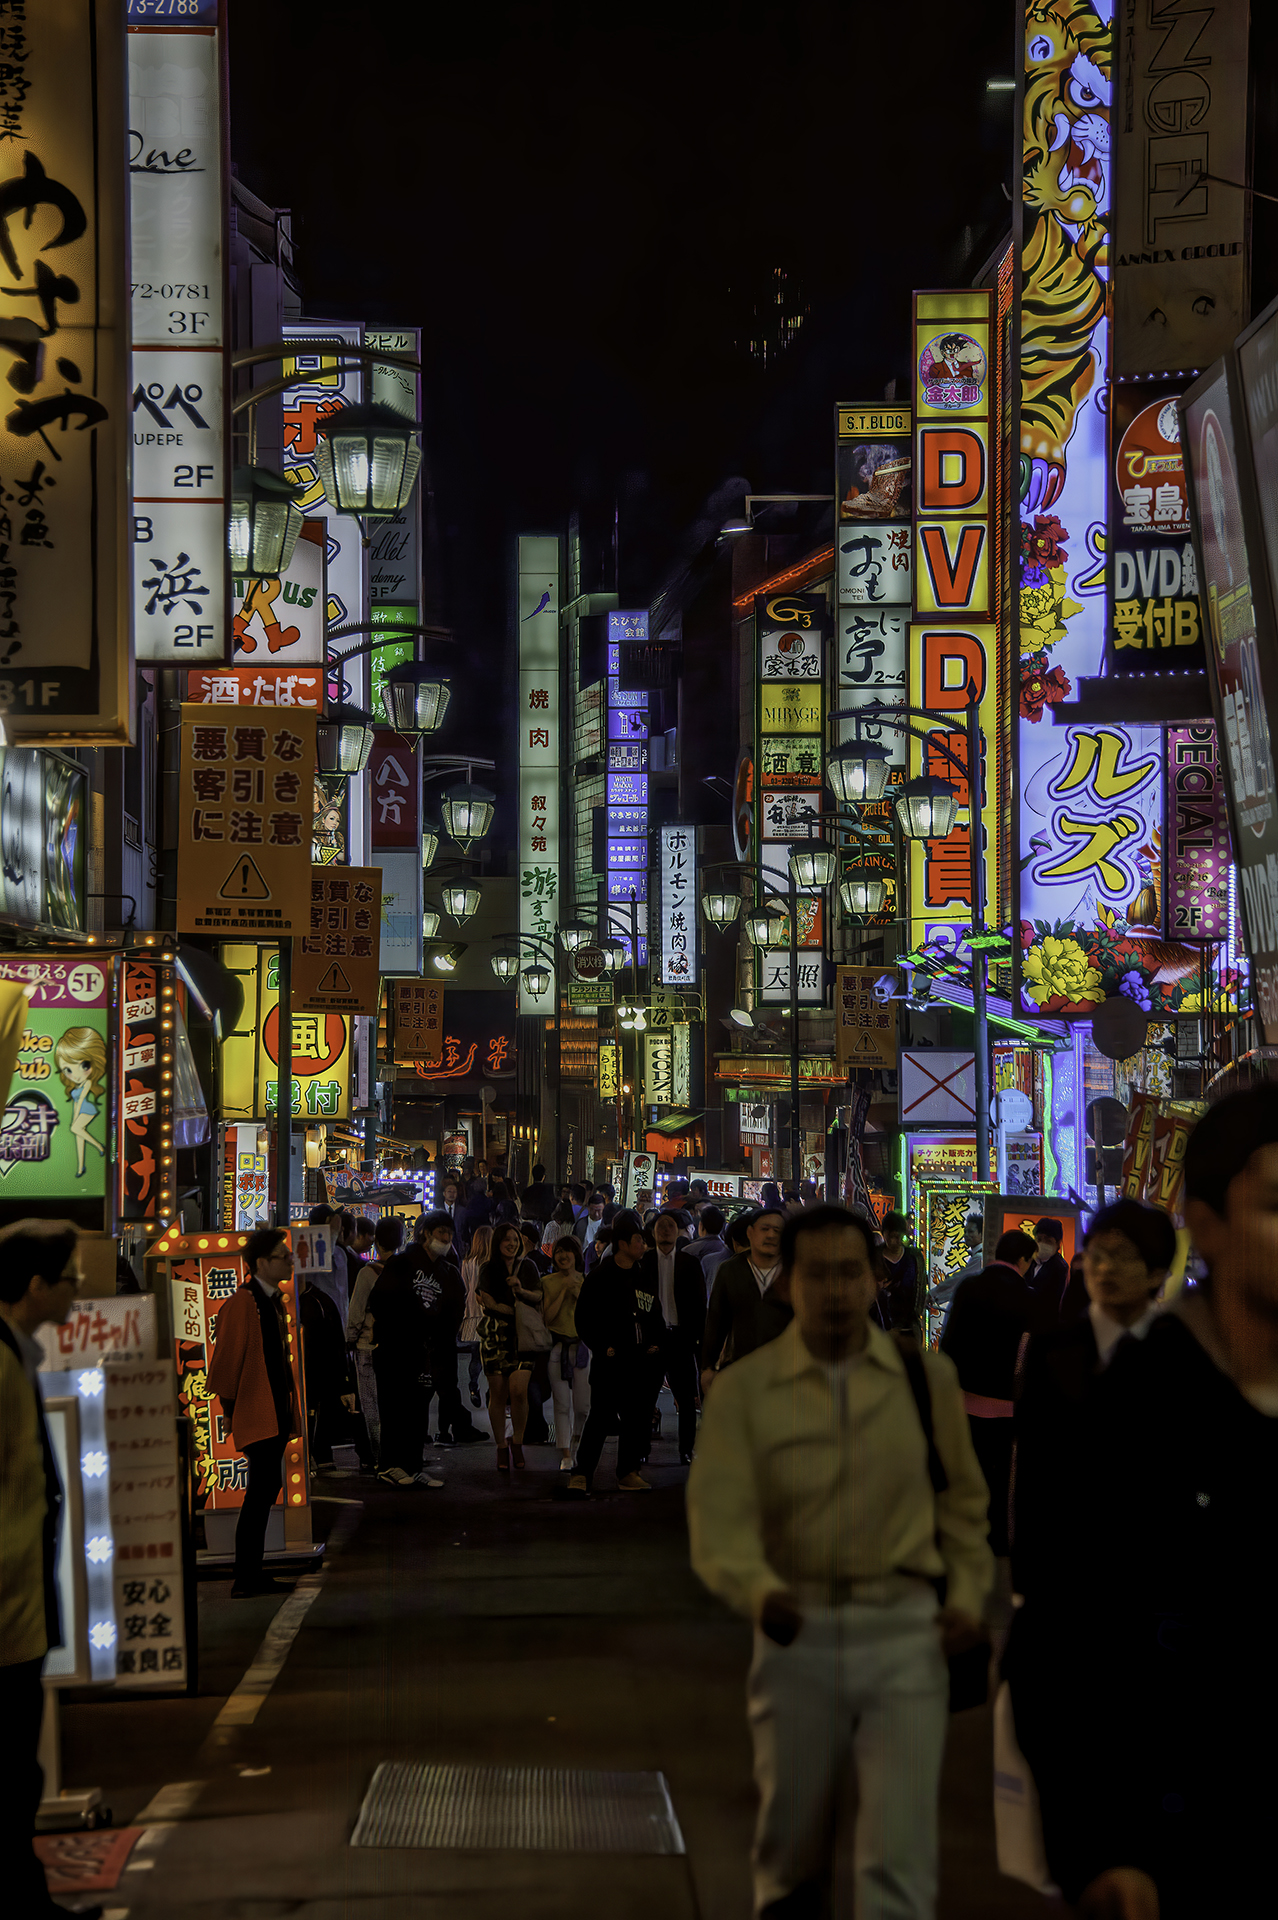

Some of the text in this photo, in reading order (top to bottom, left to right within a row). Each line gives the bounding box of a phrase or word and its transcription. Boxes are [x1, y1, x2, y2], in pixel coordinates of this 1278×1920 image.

[1117, 249, 1176, 267] ANNEX
[167, 310, 211, 335] 3F
[926, 384, 979, 404] 金太郎
[846, 415, 907, 430] S.T.BLDG.
[173, 464, 214, 489] 2F
[1122, 482, 1184, 526] 宝島
[141, 551, 211, 616] 浜
[173, 624, 214, 648] 2F
[528, 688, 550, 750] 焼肉
[764, 706, 819, 721] MIRAGE
[191, 725, 304, 764] 悪質な
[191, 766, 302, 805] 客引き
[374, 754, 410, 827] 八方
[190, 806, 304, 846] に注意
[530, 795, 548, 853] 叙々苑
[668, 830, 689, 953] ホルモン焼肉
[1174, 907, 1203, 928] 2F
[302, 933, 374, 959] に注意
[576, 955, 604, 969] 消火栓
[71, 972, 100, 992] 5F
[125, 1003, 155, 1020] 安心
[399, 1001, 439, 1015] 客引き
[399, 1016, 439, 1030] に注意
[842, 1012, 891, 1030] に注意
[125, 1047, 155, 1067] 丁寧
[125, 1096, 155, 1115] 安全
[183, 1286, 201, 1338] 良心的
[122, 1577, 171, 1607] 安心
[123, 1611, 172, 1641] 安全
